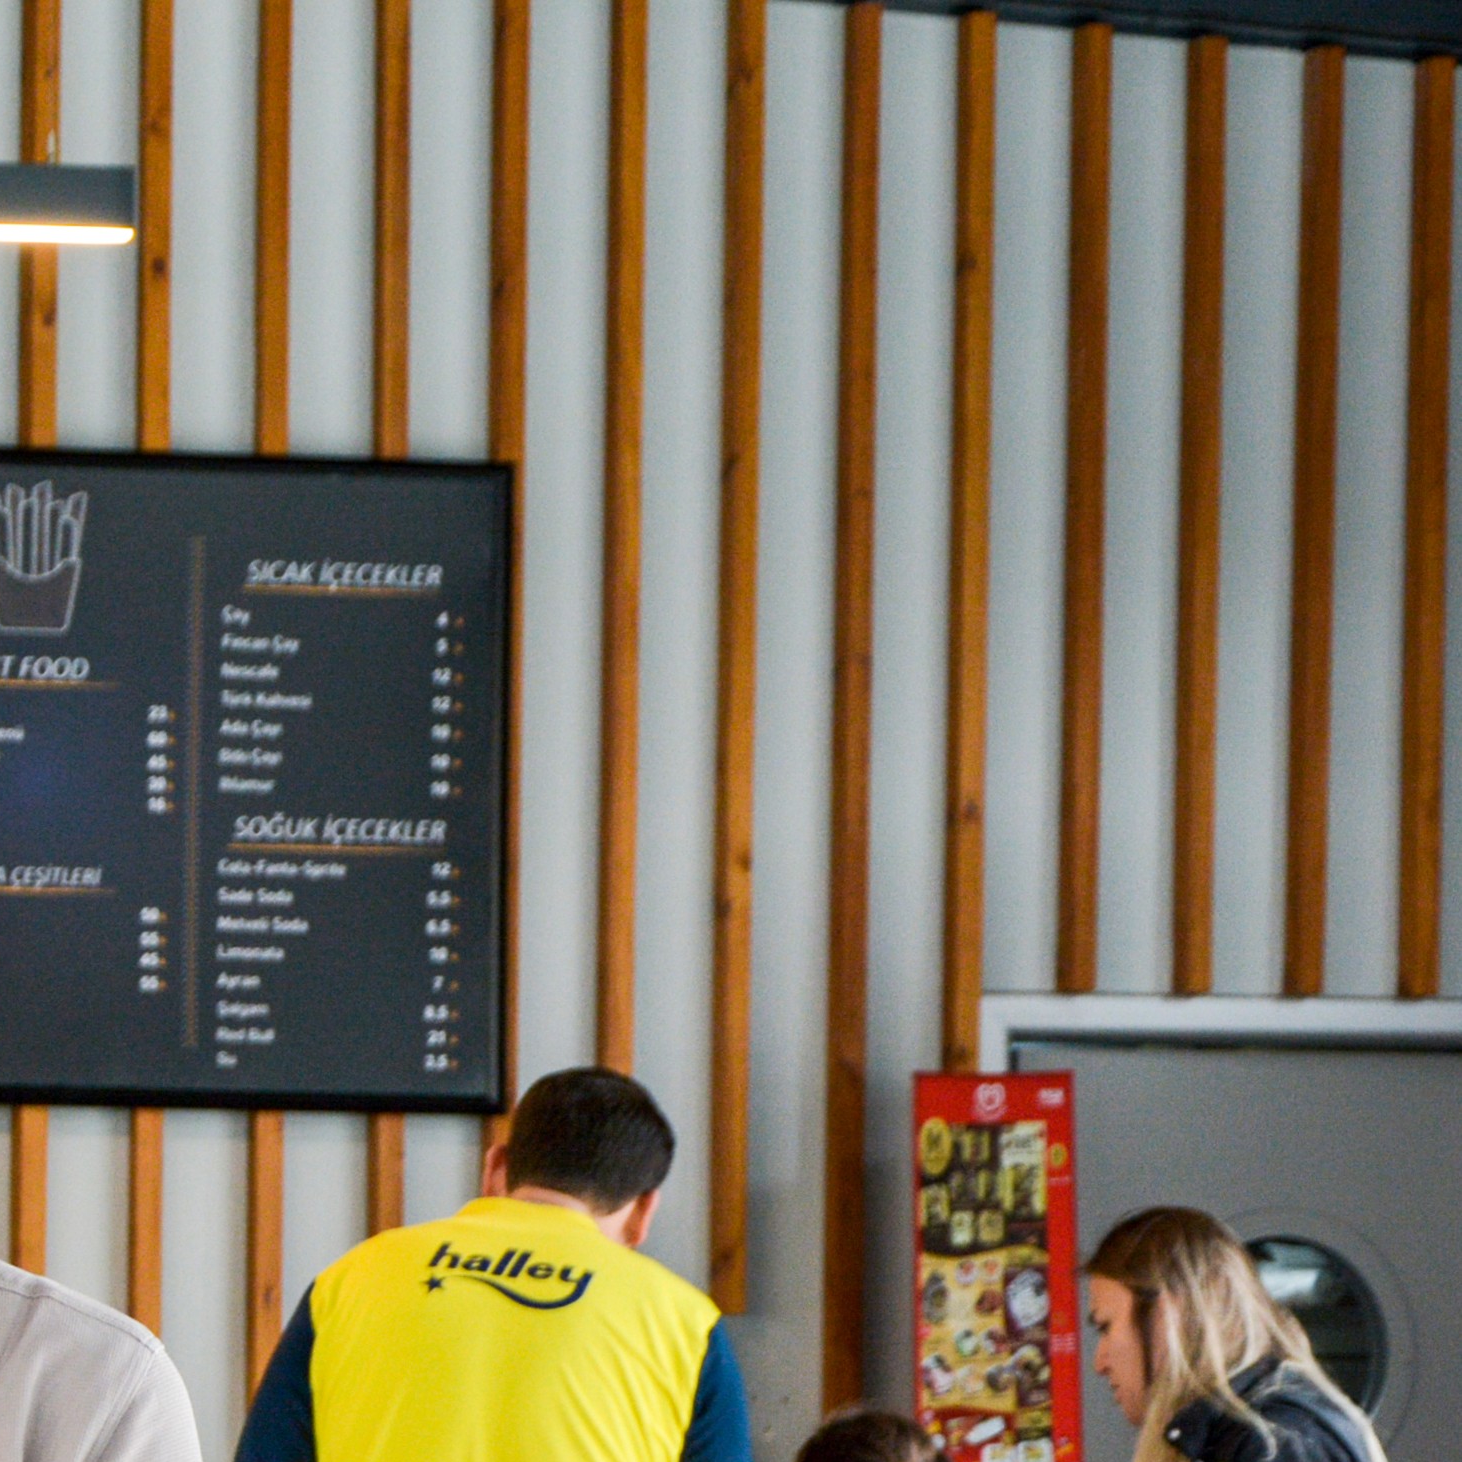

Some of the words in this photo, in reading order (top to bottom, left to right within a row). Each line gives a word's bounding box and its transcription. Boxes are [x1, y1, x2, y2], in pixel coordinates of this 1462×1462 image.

[245, 558, 317, 585] SICAK
[17, 655, 91, 681] FOOD
[233, 811, 318, 840] SOĞUK
[321, 813, 448, 848] İÇECEKLER
[428, 1242, 594, 1303] halley
